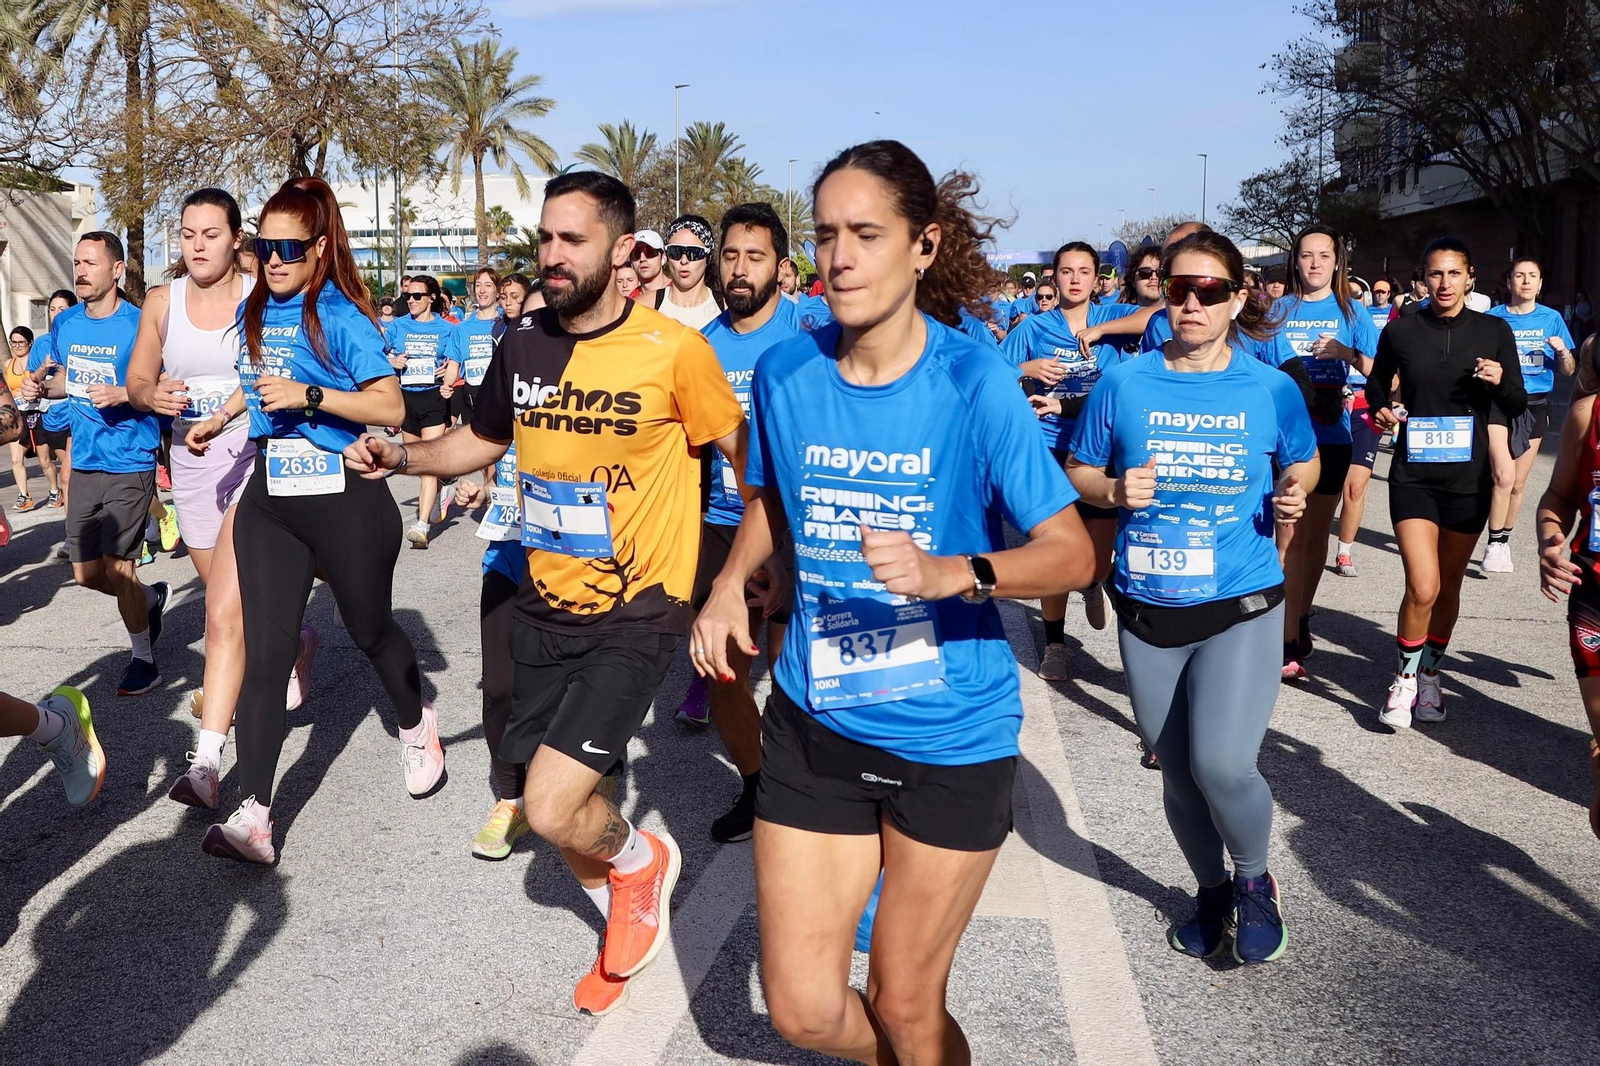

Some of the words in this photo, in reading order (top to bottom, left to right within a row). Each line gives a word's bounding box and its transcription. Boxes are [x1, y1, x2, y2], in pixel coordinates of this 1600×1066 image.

[1286, 319, 1339, 330] mayoral
[1513, 328, 1543, 338] ayoral
[70, 344, 117, 356] mayoral
[74, 371, 107, 385] 2625
[408, 366, 428, 375] 1335
[513, 373, 643, 415] bichos
[514, 406, 638, 436] runners
[1149, 411, 1246, 432] mayoral
[1425, 432, 1454, 445] 818
[1146, 440, 1244, 455] RUNNING
[279, 455, 328, 475] 2636
[805, 445, 931, 478] mayoral
[1155, 453, 1236, 467] MAKES
[532, 468, 556, 480] Colegio
[557, 471, 582, 483] Oficial
[801, 485, 927, 512] RUNNING
[552, 506, 564, 528] 1
[812, 504, 916, 530] MAKES
[525, 525, 543, 535] 10KM
[1147, 549, 1188, 571] 139
[827, 611, 853, 623] Carrera
[827, 619, 860, 631] Solidaria
[839, 629, 898, 666] 837
[814, 677, 842, 691] 10KM
